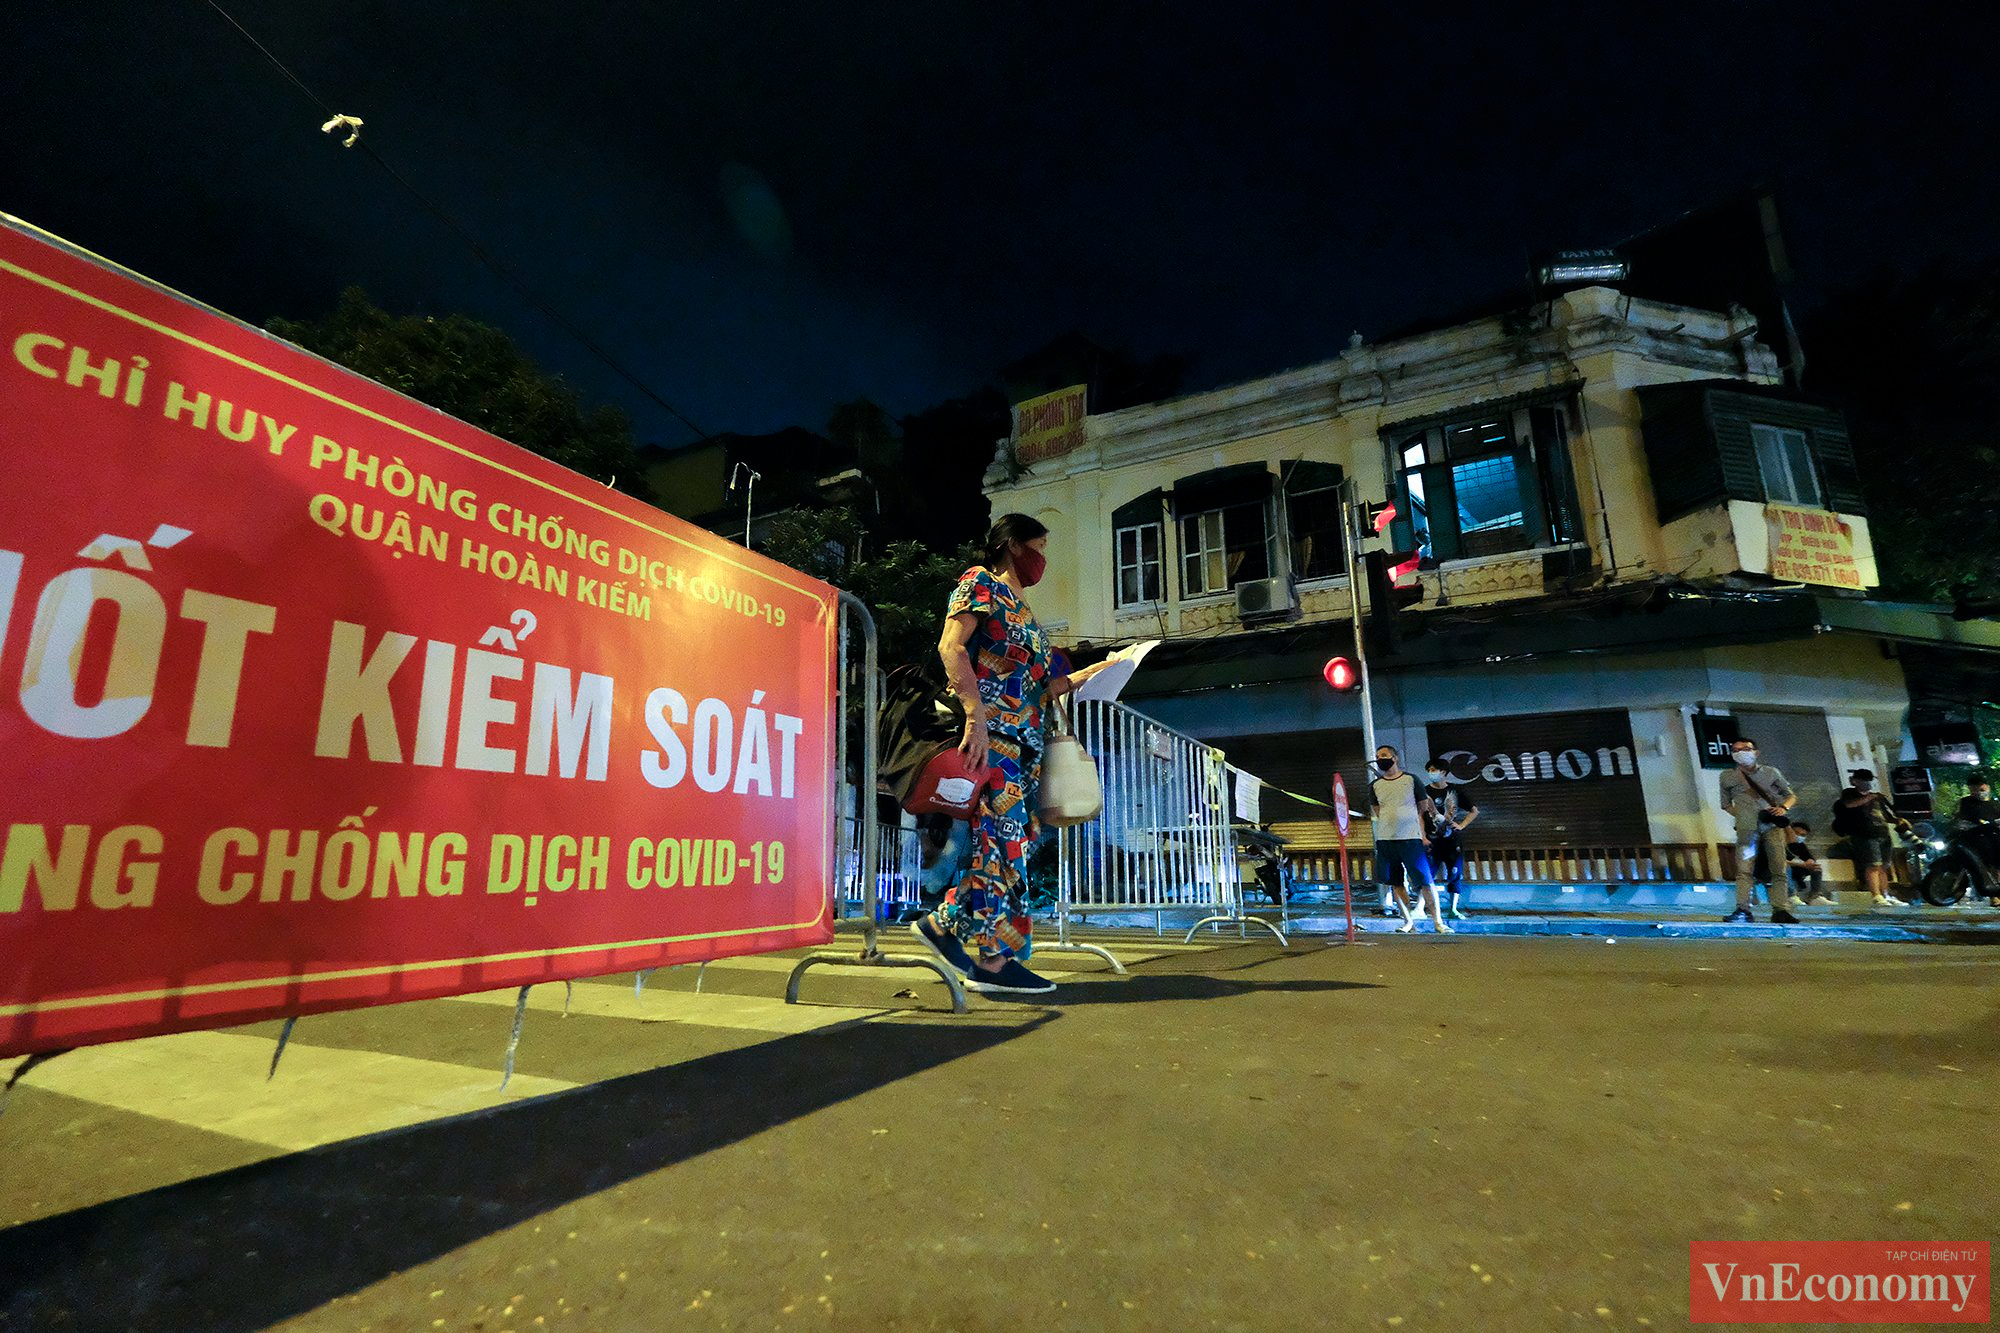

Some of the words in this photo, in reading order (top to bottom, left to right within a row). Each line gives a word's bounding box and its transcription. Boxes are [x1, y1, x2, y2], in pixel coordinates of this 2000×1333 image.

[13, 333, 149, 407] CHỈ
[163, 381, 298, 456] HUY
[309, 435, 477, 521] PHÒNG
[488, 503, 610, 567] CHỐNG
[618, 548, 684, 593] DỊCH
[690, 576, 786, 627] COVID-19
[309, 494, 448, 562] QUẬN
[460, 538, 568, 597] HOÀN
[577, 575, 651, 621] KIẾM
[314, 608, 614, 782] KIỂM
[640, 689, 803, 799] SOÁT
[1708, 734, 1733, 755] ah
[1437, 746, 1634, 784] Canon
[198, 806, 468, 906] CHỐNG
[487, 833, 610, 907] DỊCH
[626, 836, 785, 889] COVID-19
